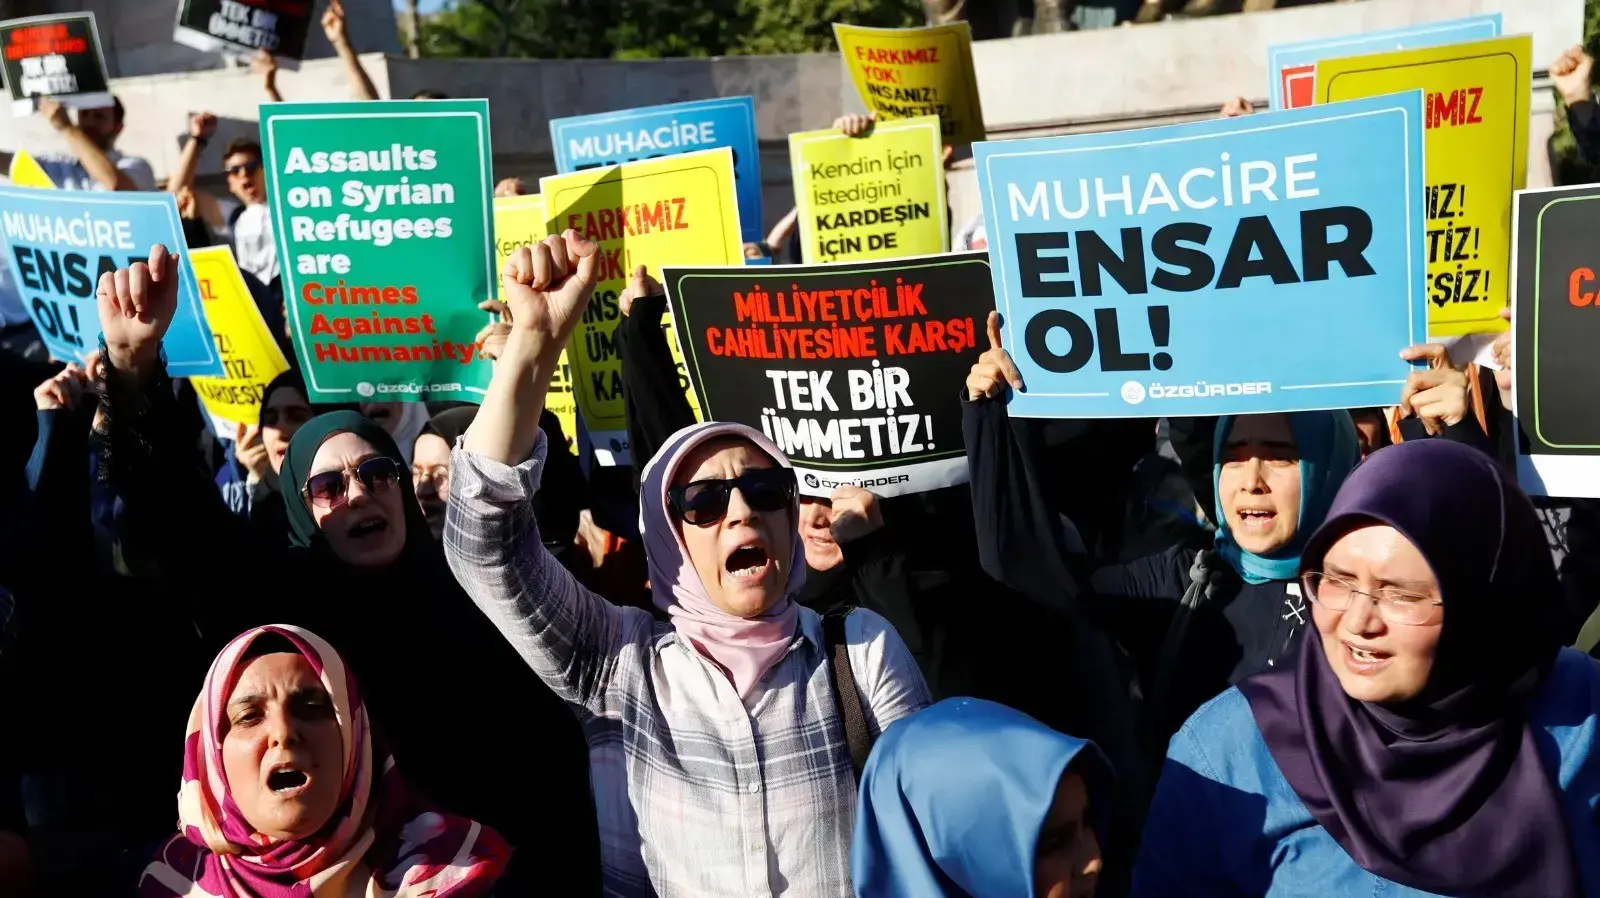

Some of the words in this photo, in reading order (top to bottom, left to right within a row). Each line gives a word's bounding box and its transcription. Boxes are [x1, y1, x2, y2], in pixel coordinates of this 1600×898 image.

[856, 46, 940, 65] FARKIMIZ
[569, 120, 717, 160] MUHACİRE
[284, 143, 438, 174] Assaults
[811, 156, 882, 180] Kendin
[887, 149, 922, 175] İçin
[287, 185, 333, 208] on
[342, 176, 455, 213] Syrian
[813, 178, 901, 206] İstediğini
[1008, 152, 1320, 222] MUHACİRE
[1426, 184, 1465, 219] IZ!
[2, 210, 136, 249] MUHACİRE
[291, 214, 453, 247] Refugees
[568, 197, 689, 242] FARKIMIZ
[816, 199, 930, 231] KARDEŞİN
[297, 253, 351, 274] are
[819, 233, 862, 261] İÇİN
[867, 232, 898, 251] DE
[1014, 205, 1377, 298] ENSAR
[302, 280, 418, 305] Crimes
[733, 277, 928, 323] MİLLİYETÇİLİK
[31, 297, 84, 348] OL!
[310, 311, 436, 341] Against
[705, 322, 879, 359] CAHİLİYESİNE
[884, 317, 977, 356] KARŞI
[1024, 305, 1174, 374] OL!
[766, 368, 840, 412] TEK
[847, 359, 915, 411] BİR
[1148, 382, 1272, 399] ÖZGÜRDER
[760, 407, 936, 460] ÜMMETİZ!
